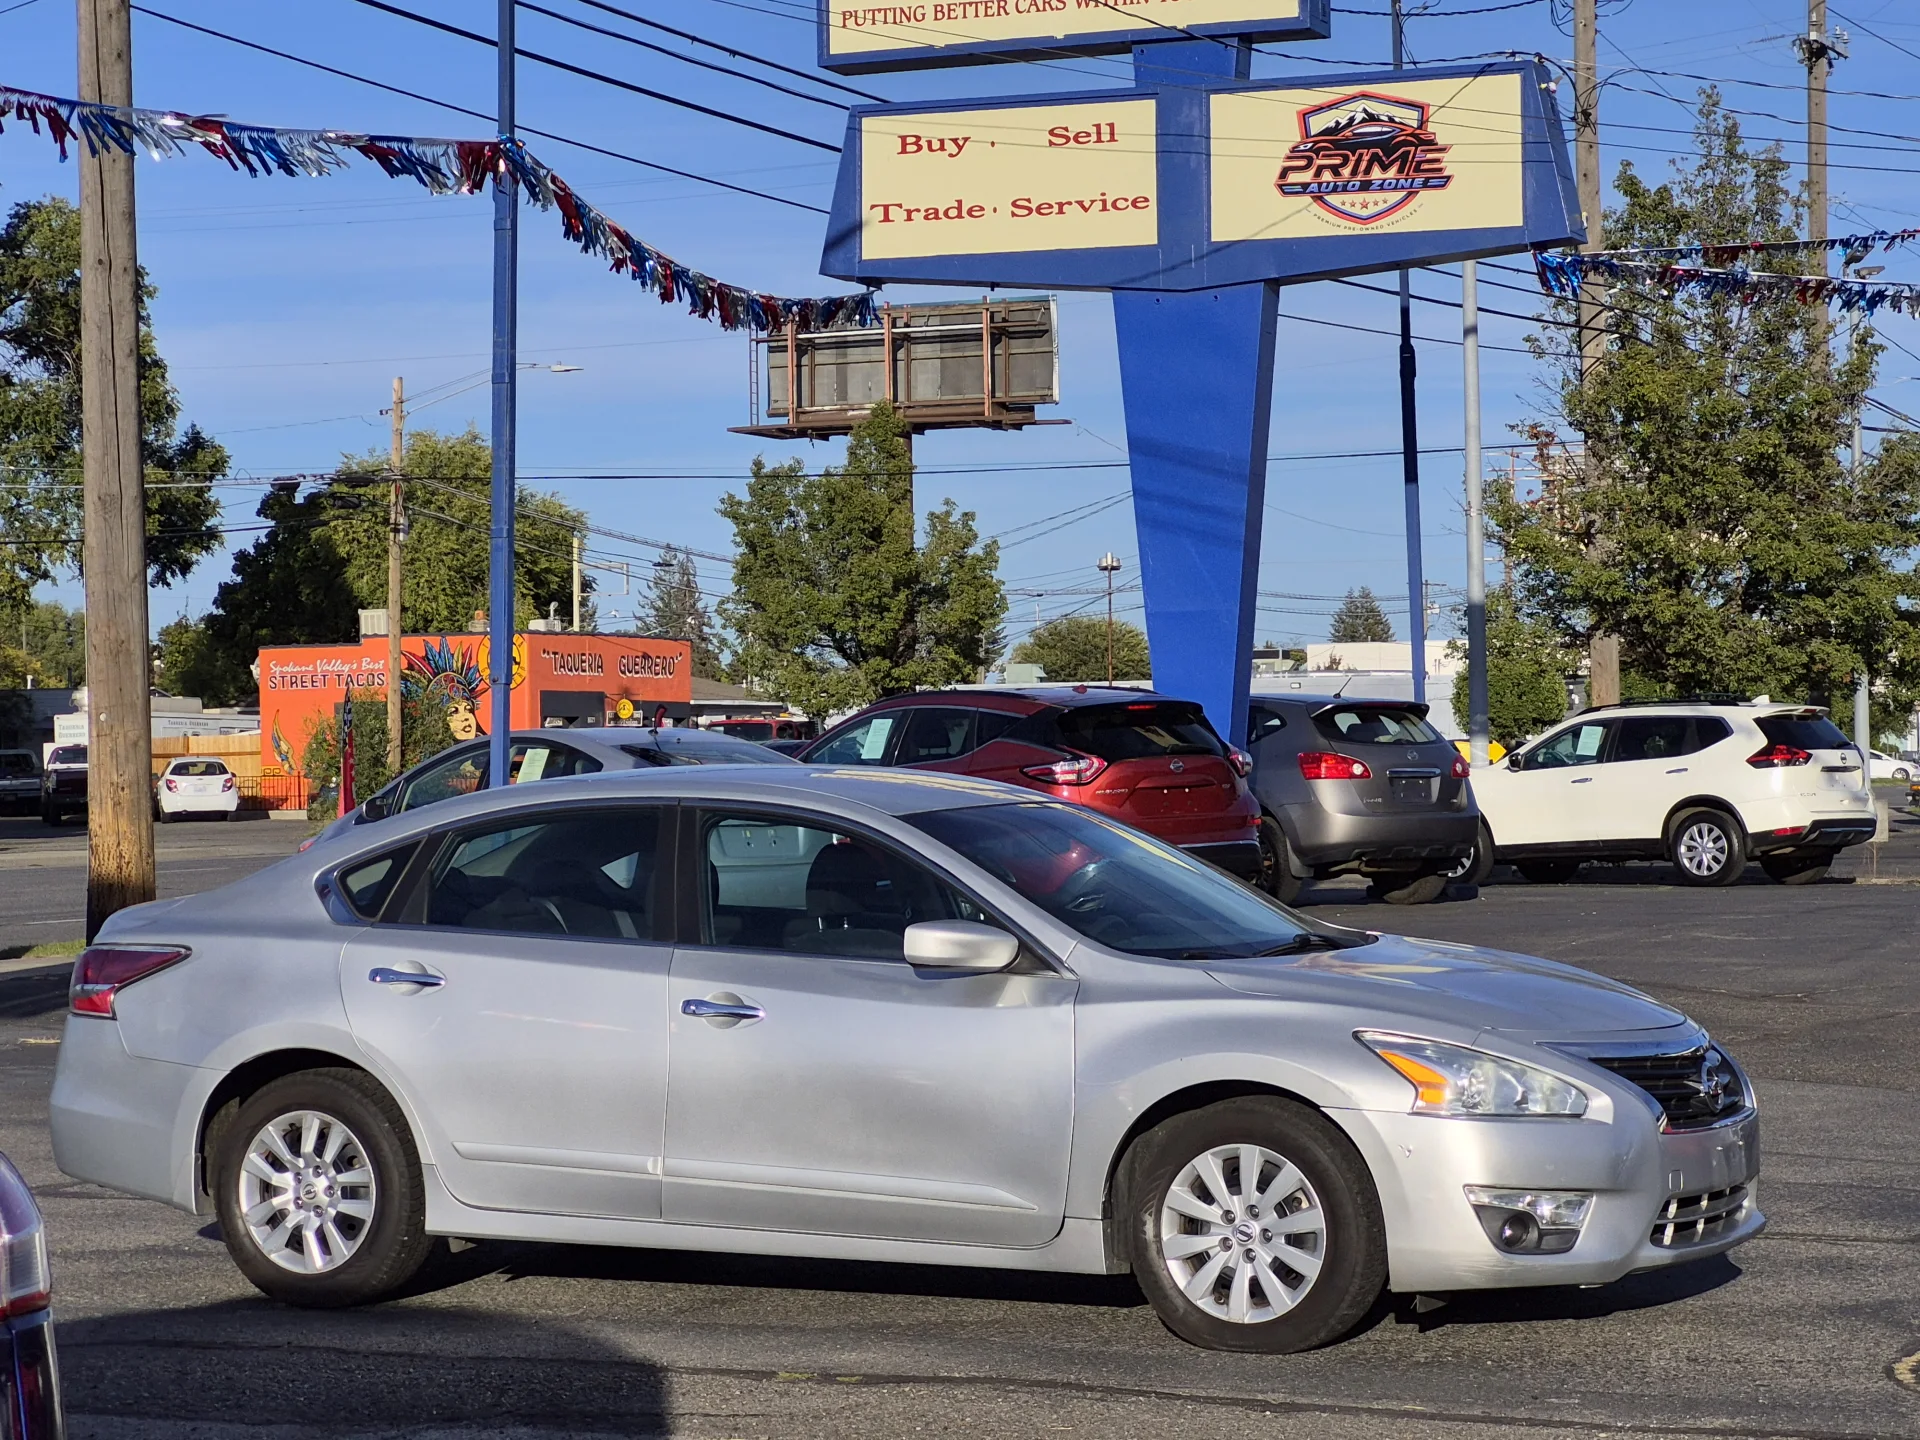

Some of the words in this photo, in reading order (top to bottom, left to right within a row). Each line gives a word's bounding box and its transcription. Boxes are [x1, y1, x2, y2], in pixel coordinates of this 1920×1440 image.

[841, 5, 927, 28] PUTTING
[933, 0, 1011, 22] BETTER
[1015, 0, 1067, 14] CARS
[896, 134, 972, 158] Buy
[1047, 122, 1119, 148] Sell
[1277, 143, 1453, 183] PRIME
[1305, 181, 1361, 194] AUTO
[1368, 177, 1425, 190] ZONE
[869, 199, 986, 223] Trade
[1010, 191, 1151, 218] Service
[1313, 213, 1341, 228] PREMIUM
[1387, 208, 1418, 226] VEHICLES
[269, 660, 315, 675] Spokane
[316, 659, 358, 673] Valley's
[361, 657, 385, 671] Best
[268, 673, 330, 691] STREET
[334, 672, 386, 689] TACOS
